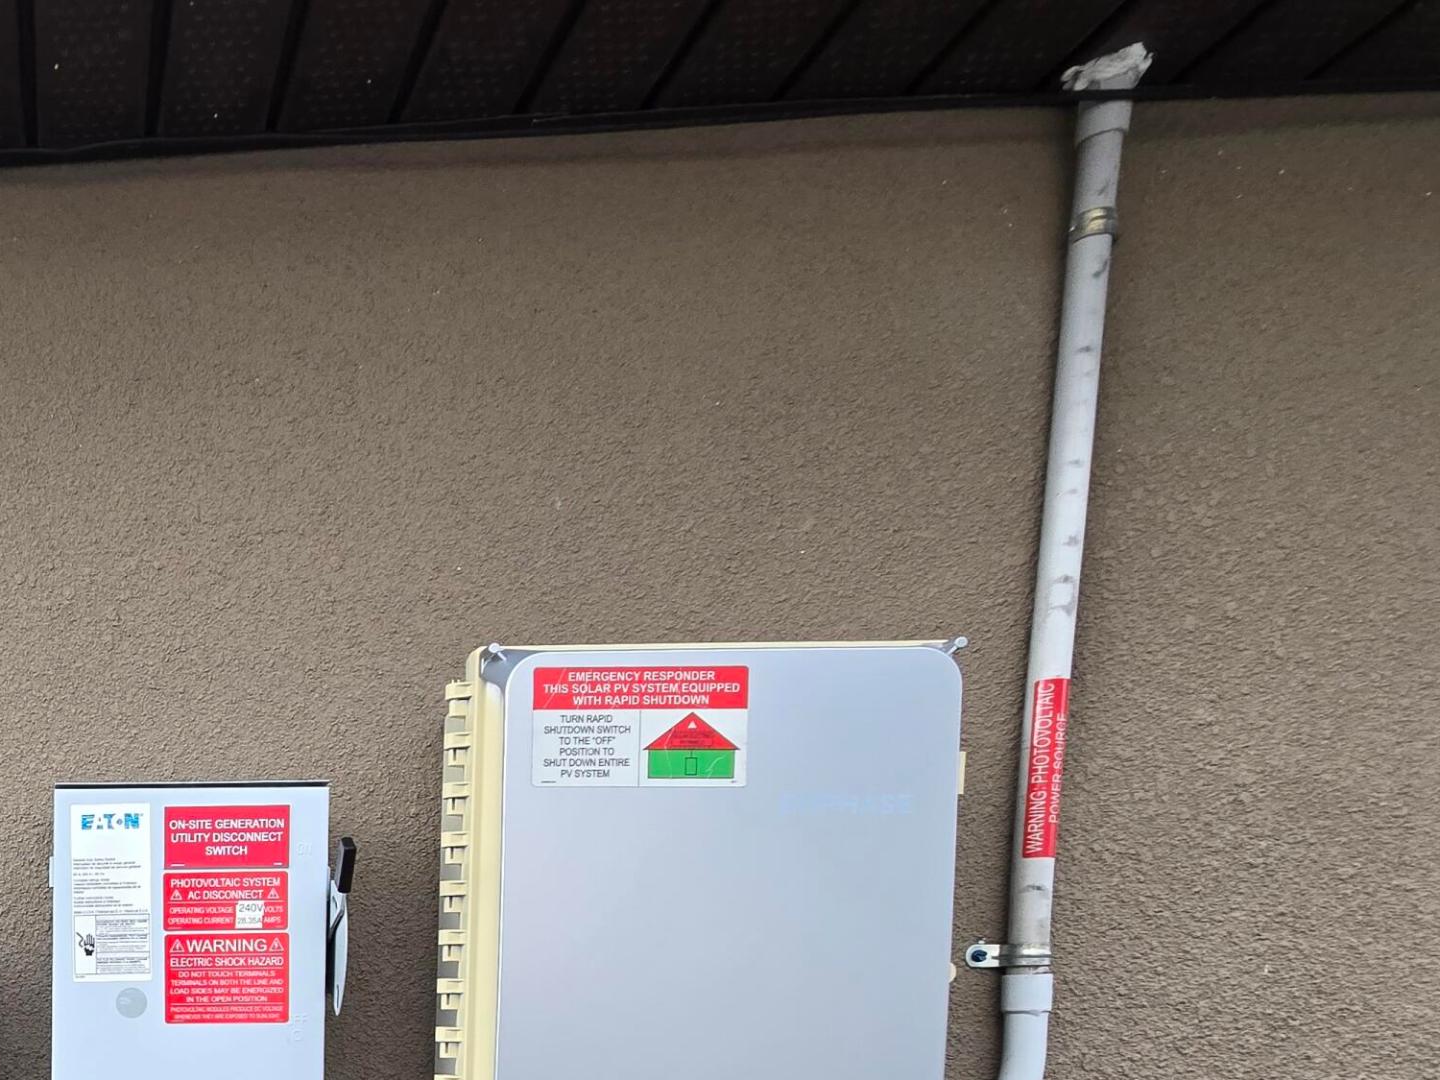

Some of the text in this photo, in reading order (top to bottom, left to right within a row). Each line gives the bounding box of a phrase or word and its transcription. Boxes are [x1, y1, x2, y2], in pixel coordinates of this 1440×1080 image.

[568, 670, 716, 682] EMERGENCY RESPONDER
[543, 682, 741, 694] THIS SOLAR PV SYSTEM EQUIPPED
[572, 695, 710, 705] WITH RAPID SHUTDOWN
[560, 714, 613, 723] TURN RAPID
[543, 725, 631, 735] SHUTDOWN SWITCH
[1031, 683, 1056, 785] PHOTOVOLTAIC
[558, 736, 571, 745] TO
[572, 736, 591, 745] THE
[559, 747, 614, 756] POSITION TO
[543, 758, 631, 767] SHUT DOWN ENTIRE
[560, 769, 610, 778] PV SYSTEM
[1049, 774, 1064, 824] POWER
[169, 818, 285, 830] ON-SITE GENERATION
[170, 831, 283, 843] UTILITY DISCONNECT
[205, 845, 248, 856] SWITCH
[170, 876, 281, 888] PHOTOVOLTAIC SYSTEM
[187, 889, 264, 900] AC DISCONNECT
[169, 903, 284, 914] OPERATING VOLTAGE 240V VOLTS
[168, 917, 204, 925] OPERATING
[203, 917, 234, 925] CURRENT
[186, 938, 268, 953] WARNING
[170, 956, 284, 967] ELECTRIC SHOCK HAZARD
[253, 978, 268, 986] LINE
[211, 995, 232, 1003] OPEN
